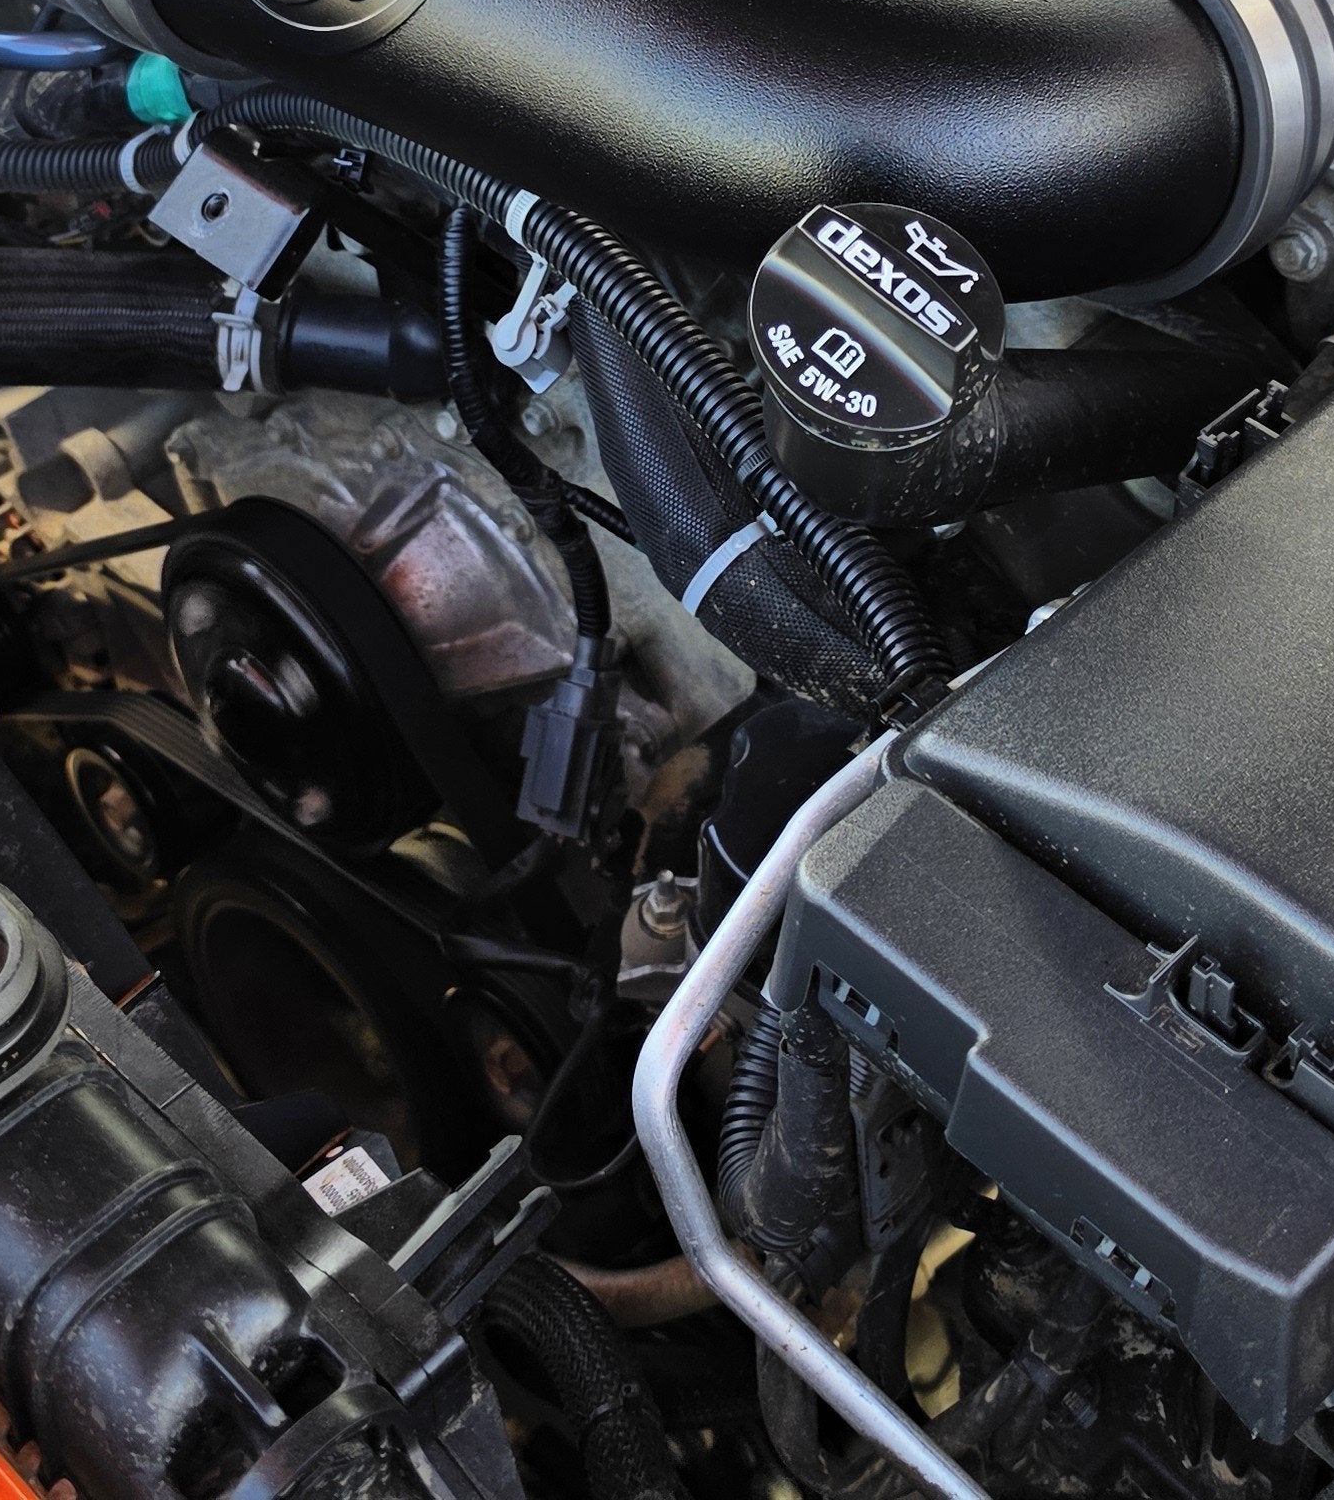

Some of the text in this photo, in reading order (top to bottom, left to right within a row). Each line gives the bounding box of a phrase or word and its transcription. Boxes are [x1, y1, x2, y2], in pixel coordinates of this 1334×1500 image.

[817, 220, 957, 337] dexos
[767, 323, 878, 418] SAE 5W-30
